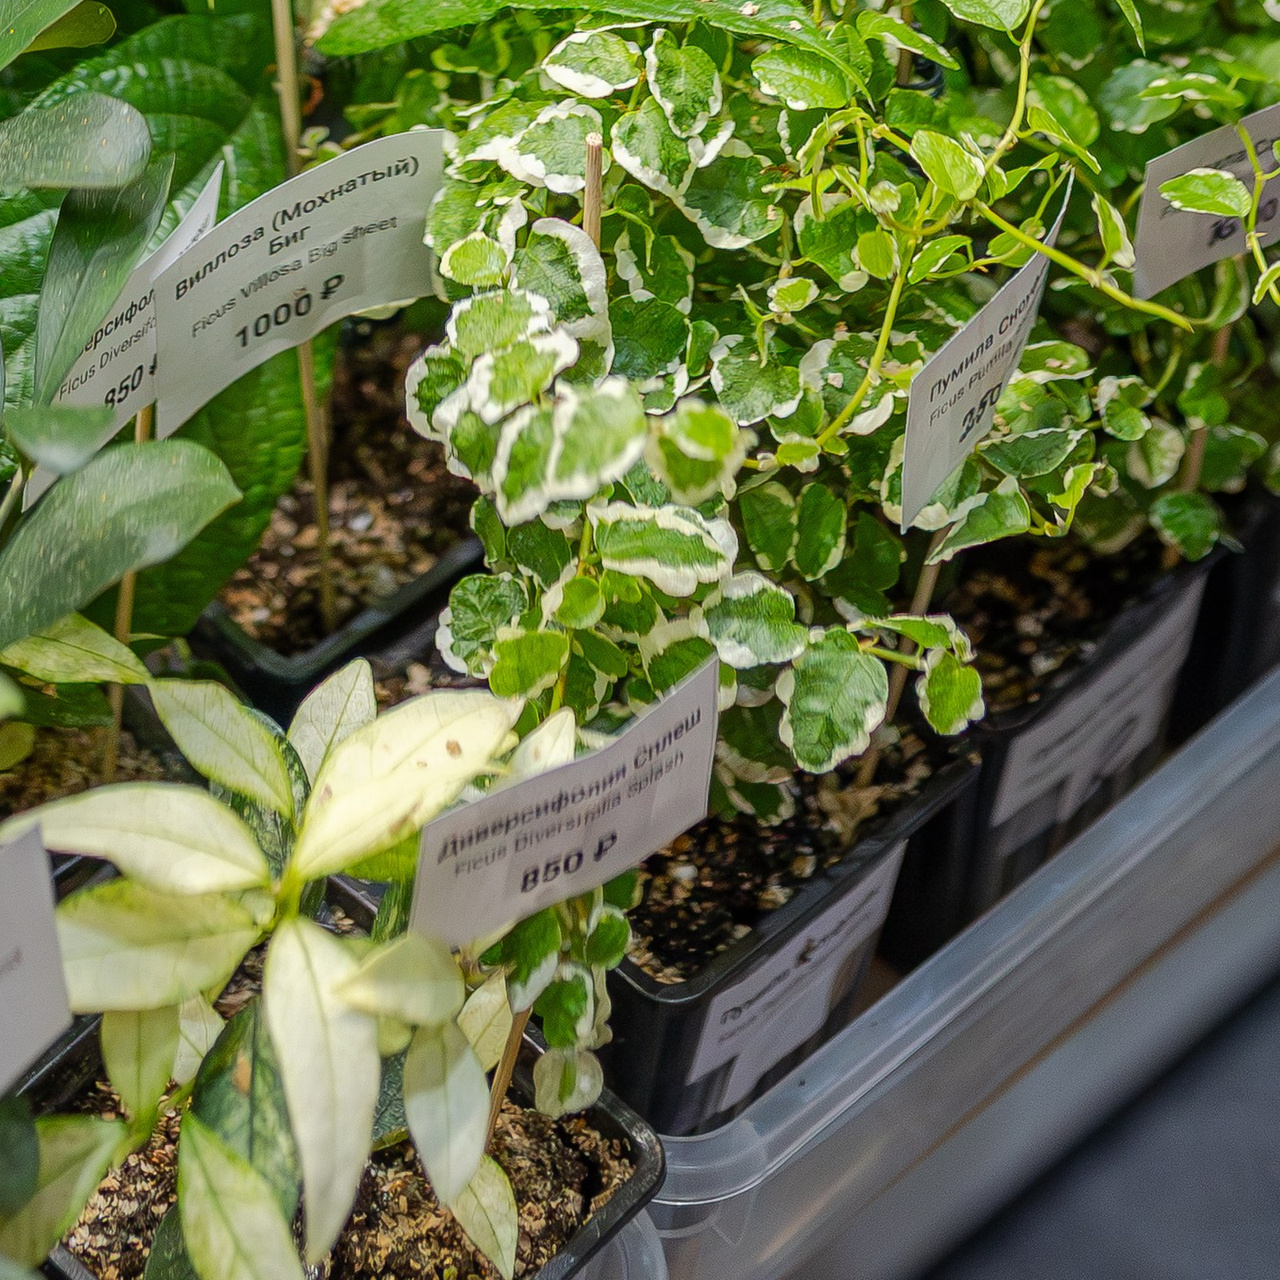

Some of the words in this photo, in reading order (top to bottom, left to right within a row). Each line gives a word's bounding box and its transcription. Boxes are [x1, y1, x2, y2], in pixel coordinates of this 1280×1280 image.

[175, 226, 264, 300] Виллоза
[273, 156, 419, 232] (Мохнатый)
[269, 226, 311, 256] Биг
[192, 298, 236, 337] Ficus
[240, 260, 303, 298] Villosa
[309, 241, 338, 263] Big
[235, 293, 312, 347] 1000
[59, 365, 96, 401] Ficus
[930, 334, 994, 402] Пумила
[930, 387, 964, 426] Ficus
[521, 850, 583, 892] 850
